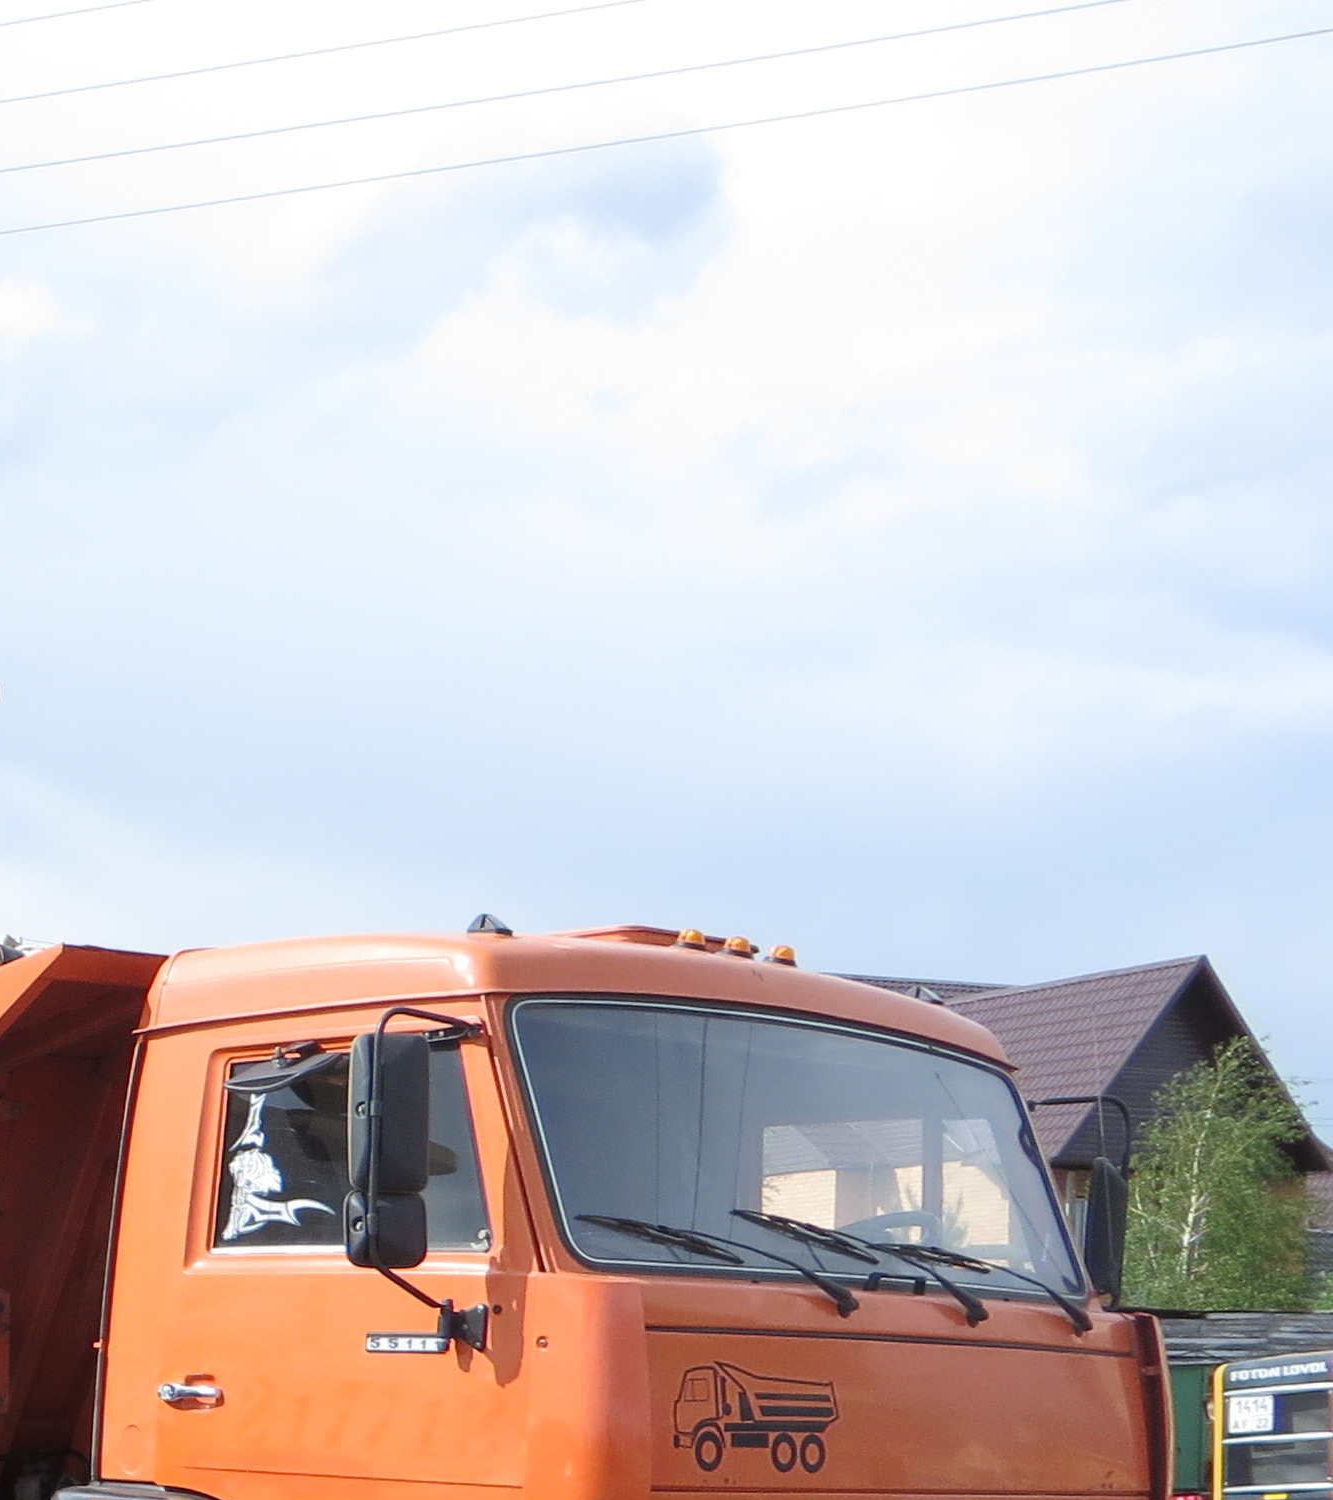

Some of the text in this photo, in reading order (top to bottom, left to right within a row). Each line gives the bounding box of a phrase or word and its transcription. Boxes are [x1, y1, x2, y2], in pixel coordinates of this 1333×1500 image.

[1229, 1366, 1281, 1382] FOTON
[1235, 1398, 1268, 1414] 1414
[1255, 1417, 1269, 1429] 22
